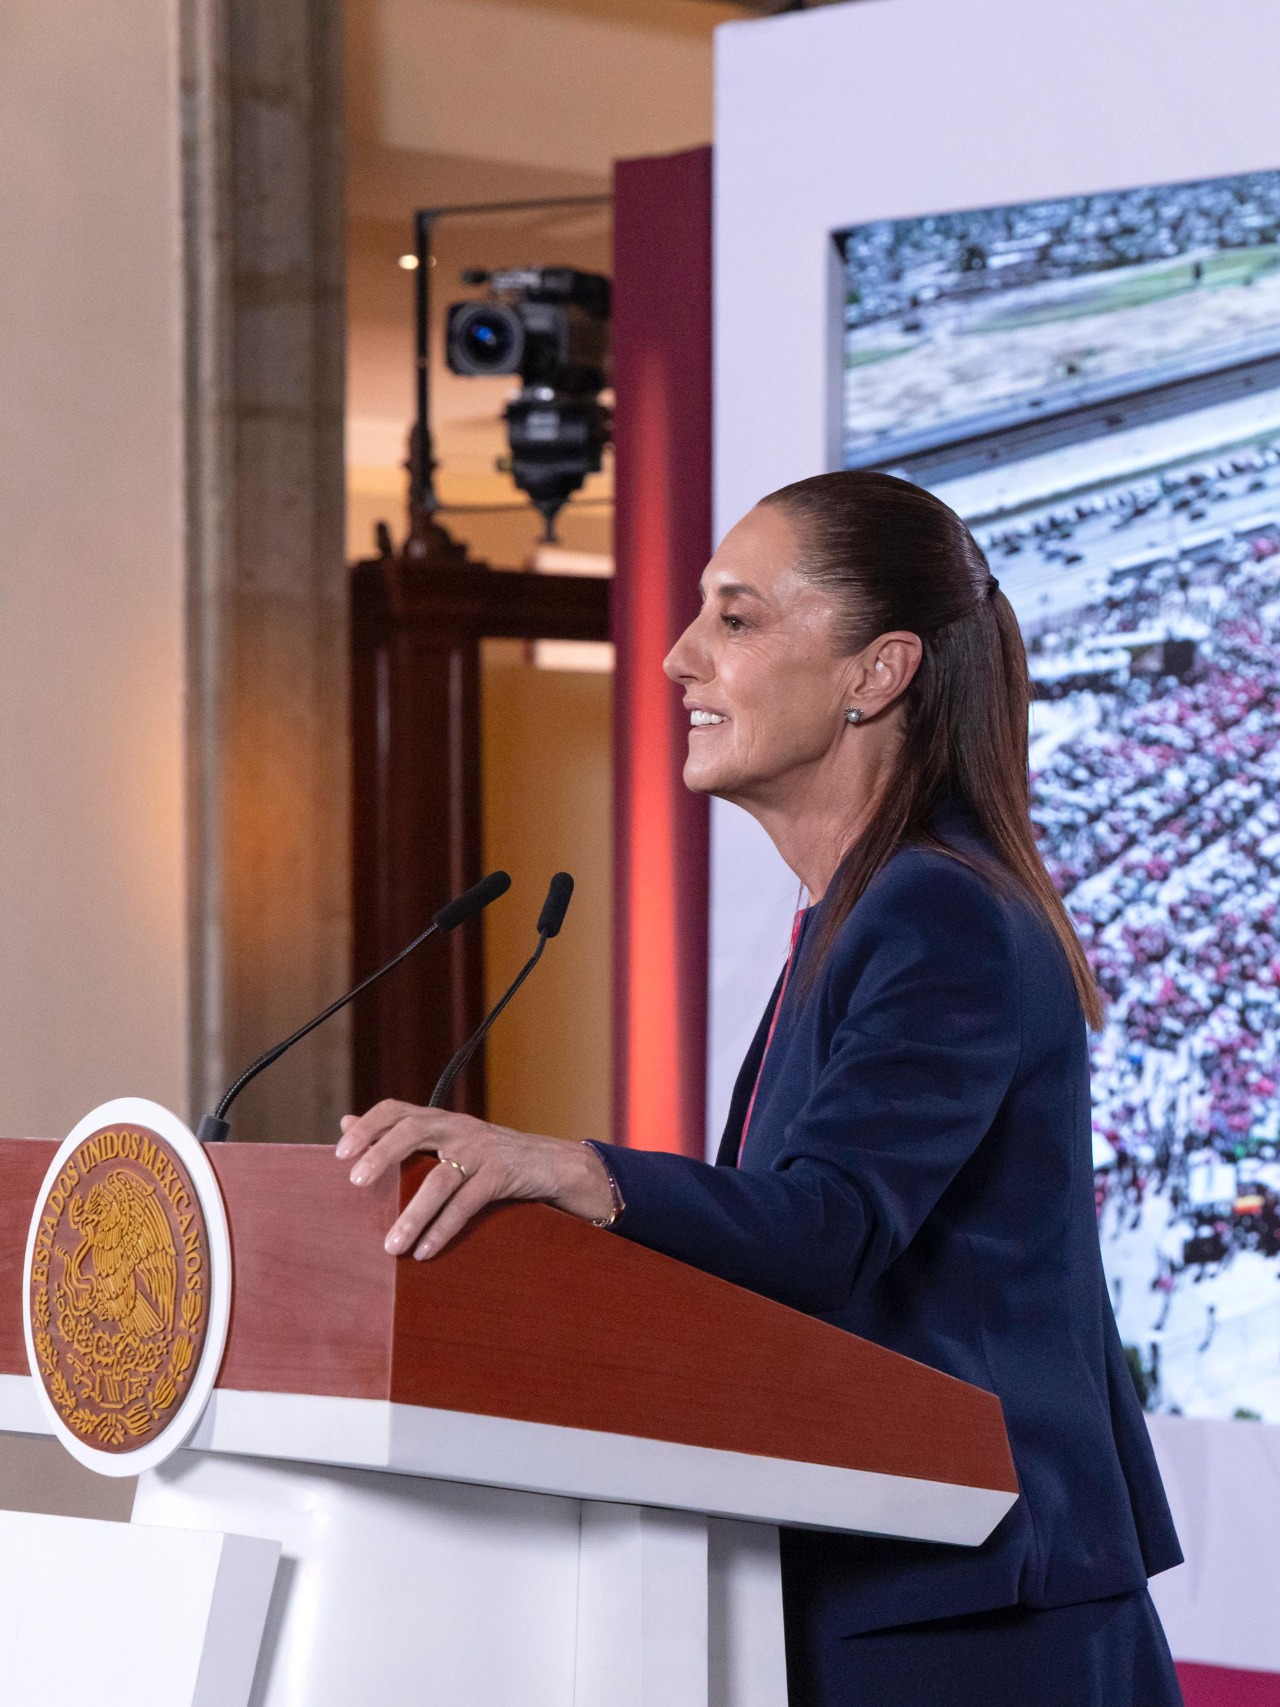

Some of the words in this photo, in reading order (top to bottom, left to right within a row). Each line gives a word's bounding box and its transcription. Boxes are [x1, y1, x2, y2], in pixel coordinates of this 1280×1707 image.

[34, 1160, 80, 1284] ESTADOS
[78, 1131, 140, 1174] UNIDOS
[140, 1138, 202, 1290] MEXICANOS
